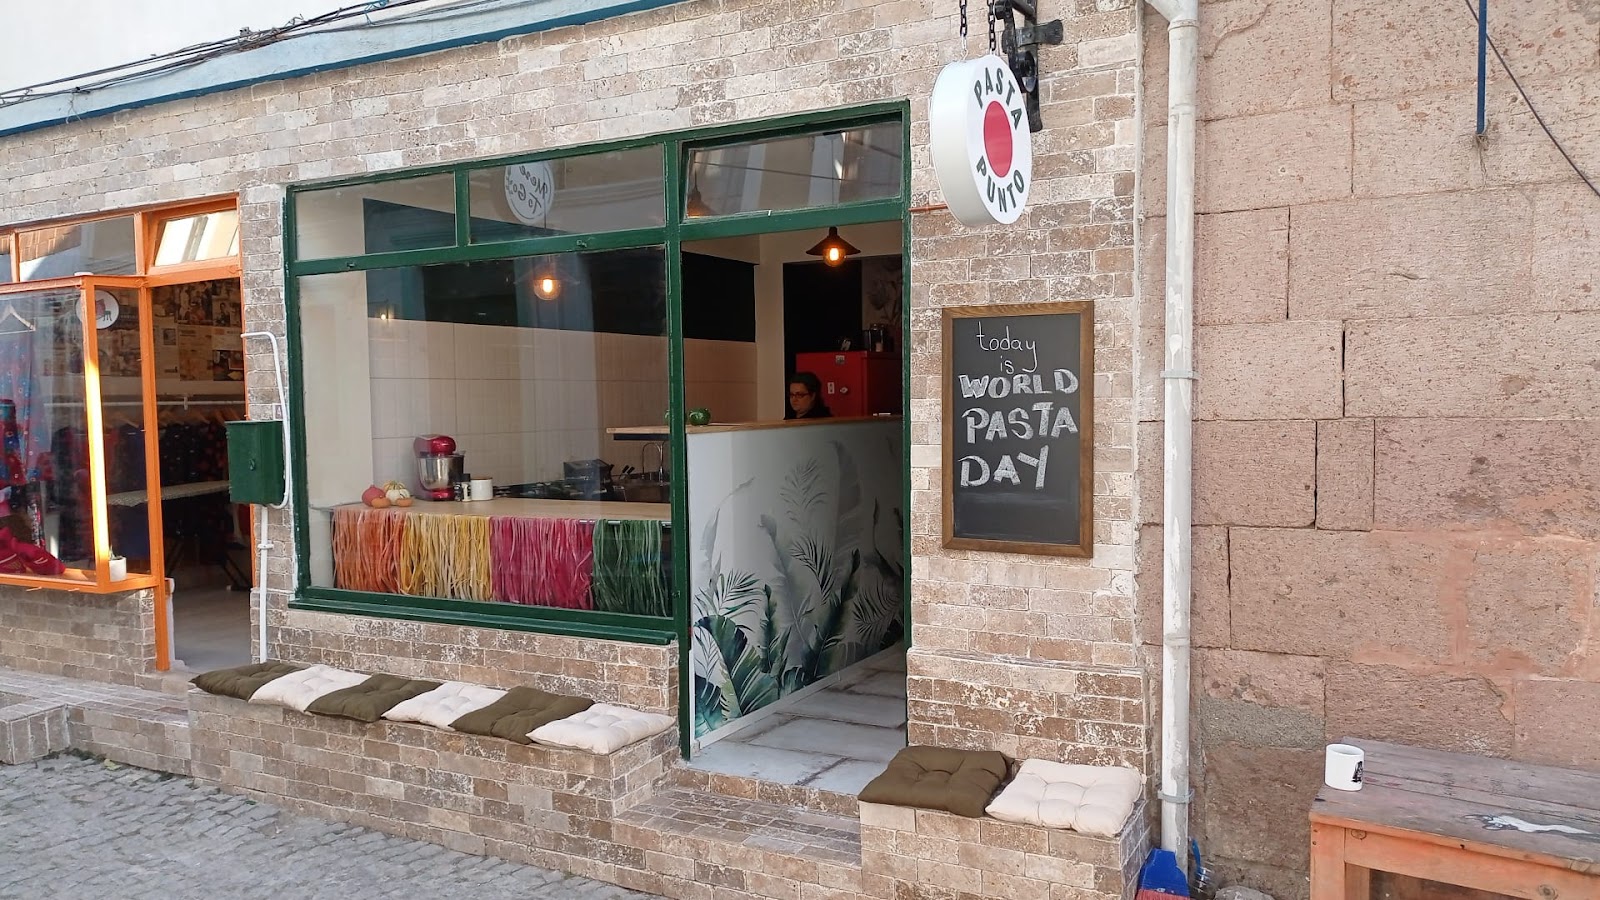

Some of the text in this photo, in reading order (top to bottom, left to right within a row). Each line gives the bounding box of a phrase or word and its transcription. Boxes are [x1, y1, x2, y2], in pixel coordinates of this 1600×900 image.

[974, 67, 1022, 130] PASTA
[976, 155, 1024, 213] PUNTO
[976, 321, 1038, 373] today
[1000, 355, 1014, 375] is
[958, 368, 1079, 399] WORLD
[961, 401, 1078, 444] PASTA
[957, 444, 1049, 490] DAY
